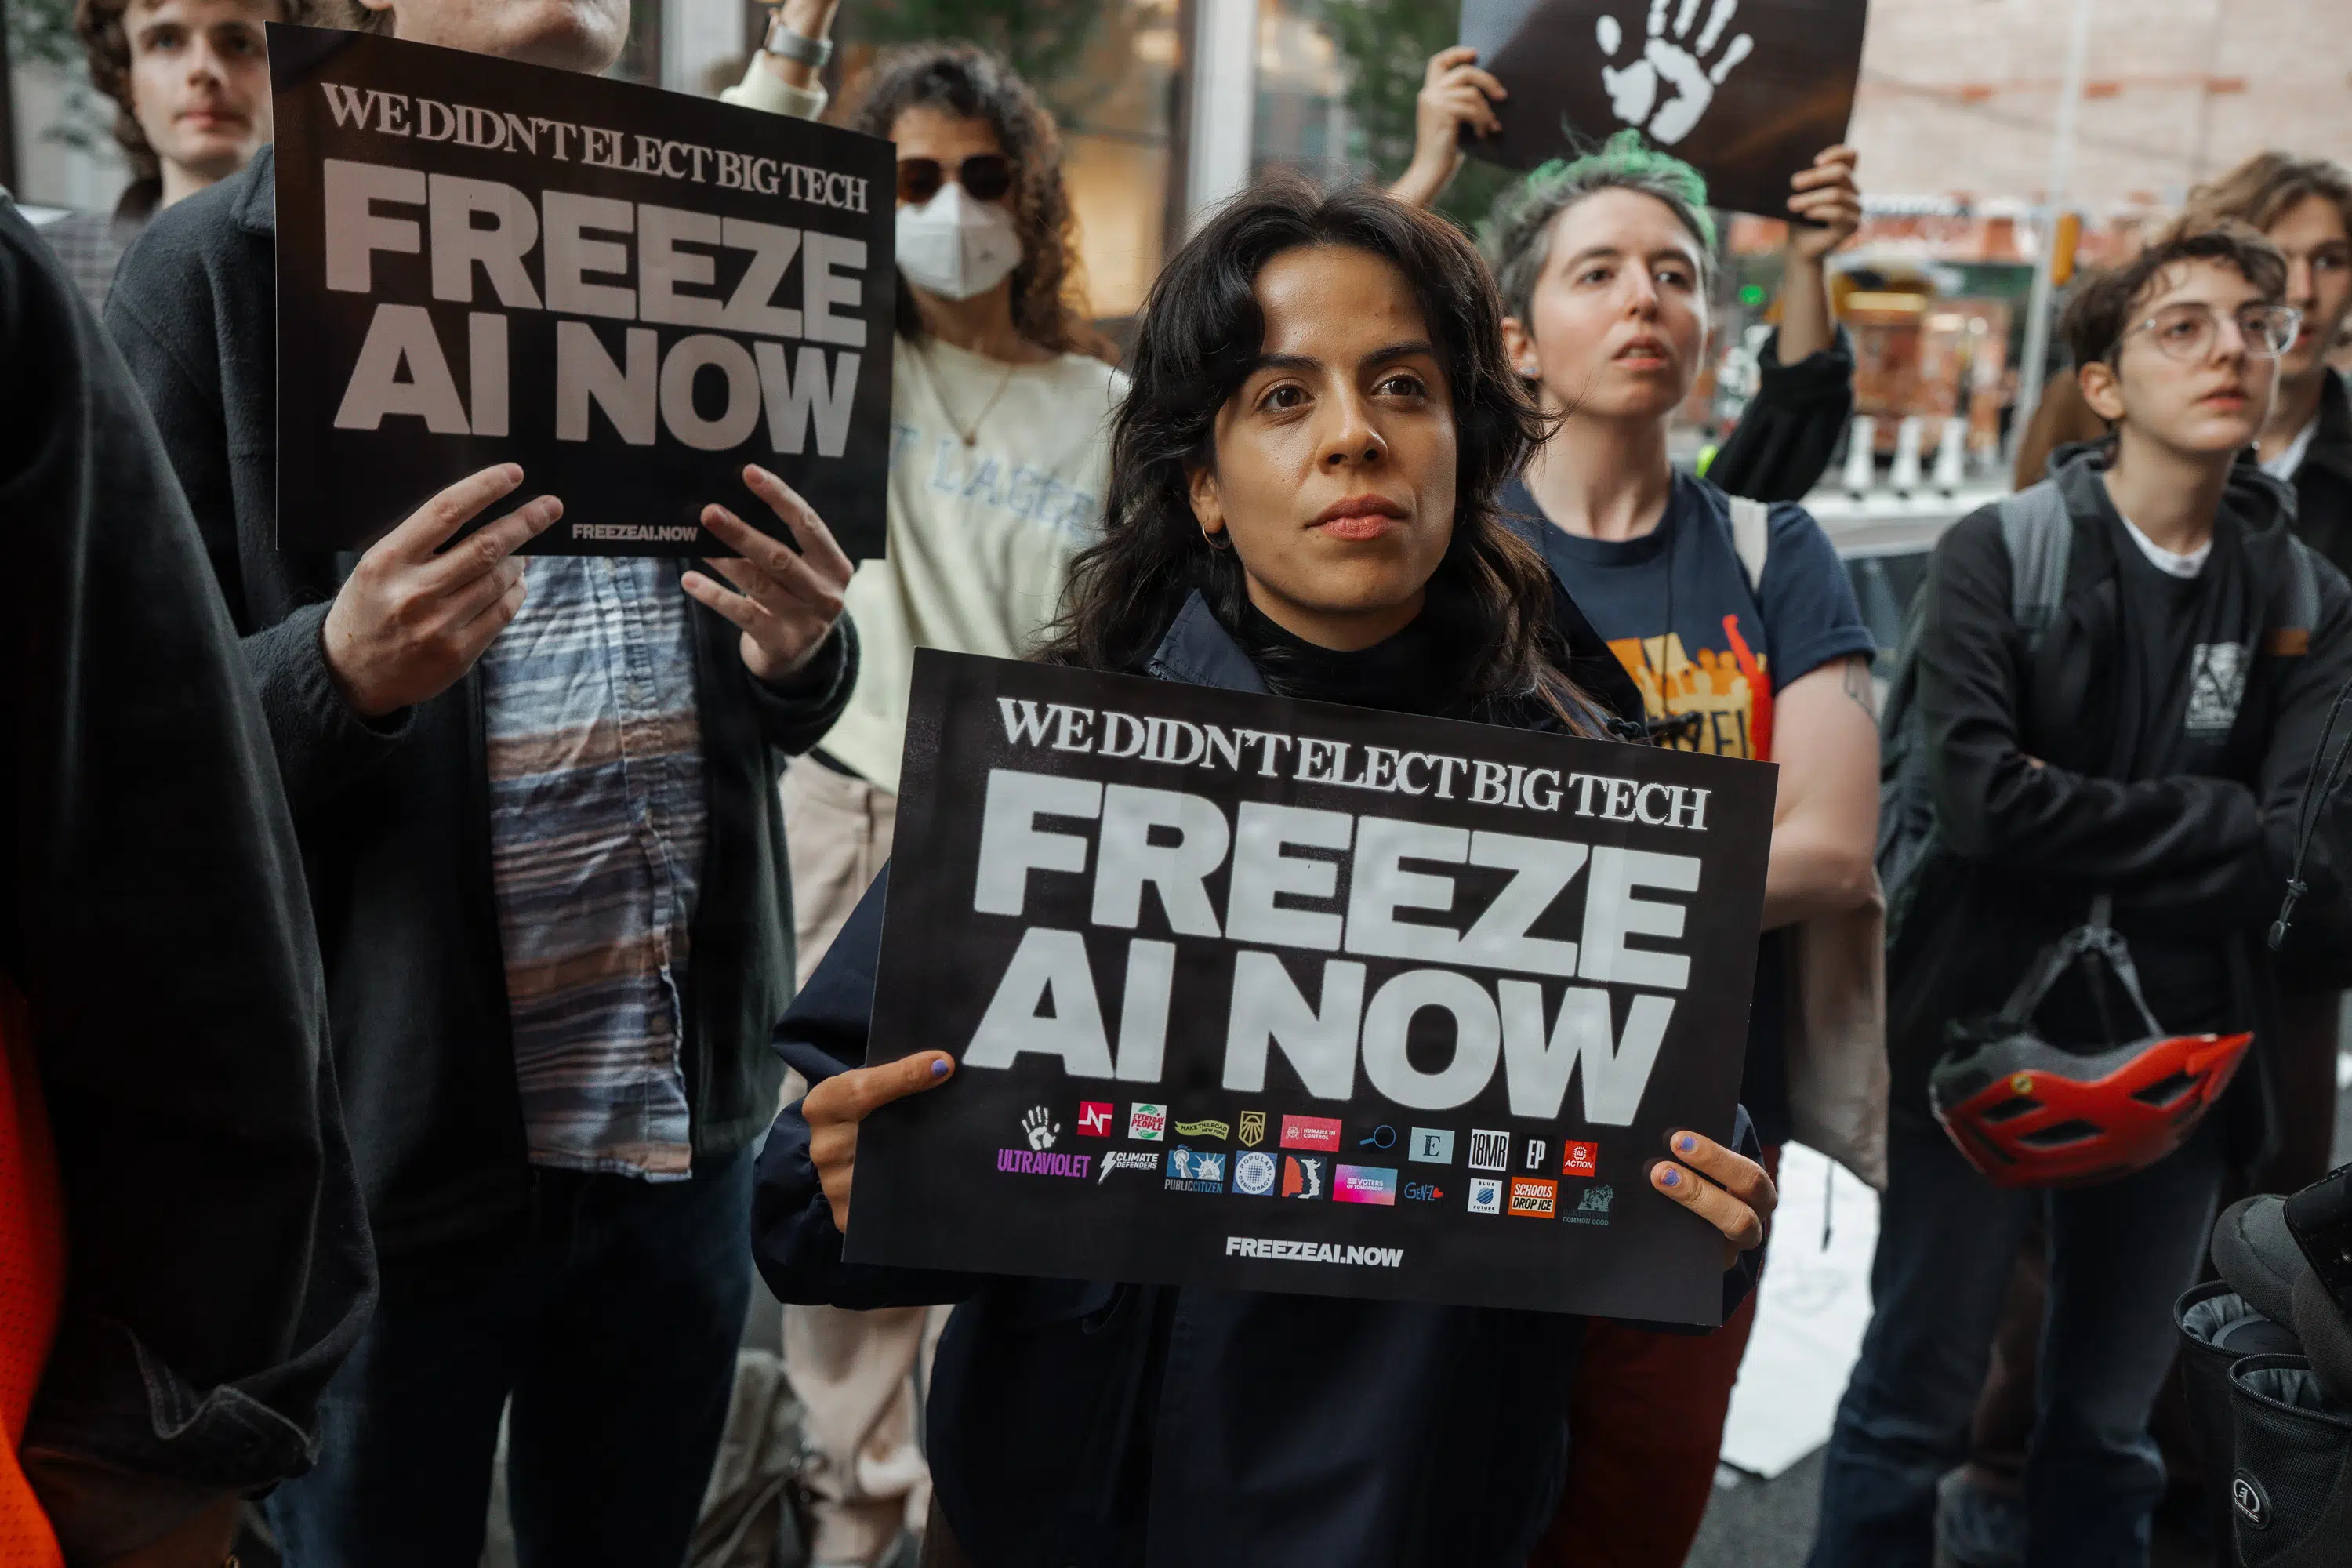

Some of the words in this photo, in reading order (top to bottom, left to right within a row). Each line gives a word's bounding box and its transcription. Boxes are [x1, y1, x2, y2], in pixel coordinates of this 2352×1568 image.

[321, 82, 411, 136] WE
[416, 99, 577, 161] DIDN'T
[580, 125, 713, 183] ELECT
[715, 150, 781, 194] BIG
[782, 162, 868, 213] TECH
[324, 158, 867, 347] FREEZE
[334, 303, 509, 437] AI
[556, 321, 862, 458] NOW
[572, 523, 698, 543] FREEZEAI.NOW
[997, 698, 1094, 753] WE
[1098, 711, 1291, 777] DIDN'T
[1293, 737, 1468, 798] ELECT
[1468, 760, 1563, 812] BIG
[1569, 773, 1712, 831] TECH
[974, 768, 1702, 989] FREEZE
[962, 927, 1176, 1083] AI
[1222, 951, 1676, 1127] NOW
[1131, 1120, 1163, 1131] PEOPLE
[1133, 1113, 1165, 1123] EVERYDAY
[1210, 1122, 1228, 1132] ROAD
[1422, 1134, 1441, 1157] E
[1472, 1133, 1508, 1168] 18MR
[1526, 1139, 1546, 1169] EP
[996, 1148, 1091, 1178] ULTRAVIOLET
[1116, 1152, 1159, 1162] CLIMATE
[1116, 1161, 1158, 1170] DEFENDERS
[1240, 1154, 1272, 1171] POPULAR
[1565, 1160, 1593, 1168] ACTION
[1238, 1175, 1270, 1192] DEMOCRACY
[1514, 1183, 1553, 1198] SCHOOLS
[1512, 1196, 1537, 1210] DROP
[1538, 1199, 1552, 1211] ICE
[1563, 1216, 1591, 1225] COMMON
[1225, 1236, 1404, 1268] FREEZEAI.NOW
